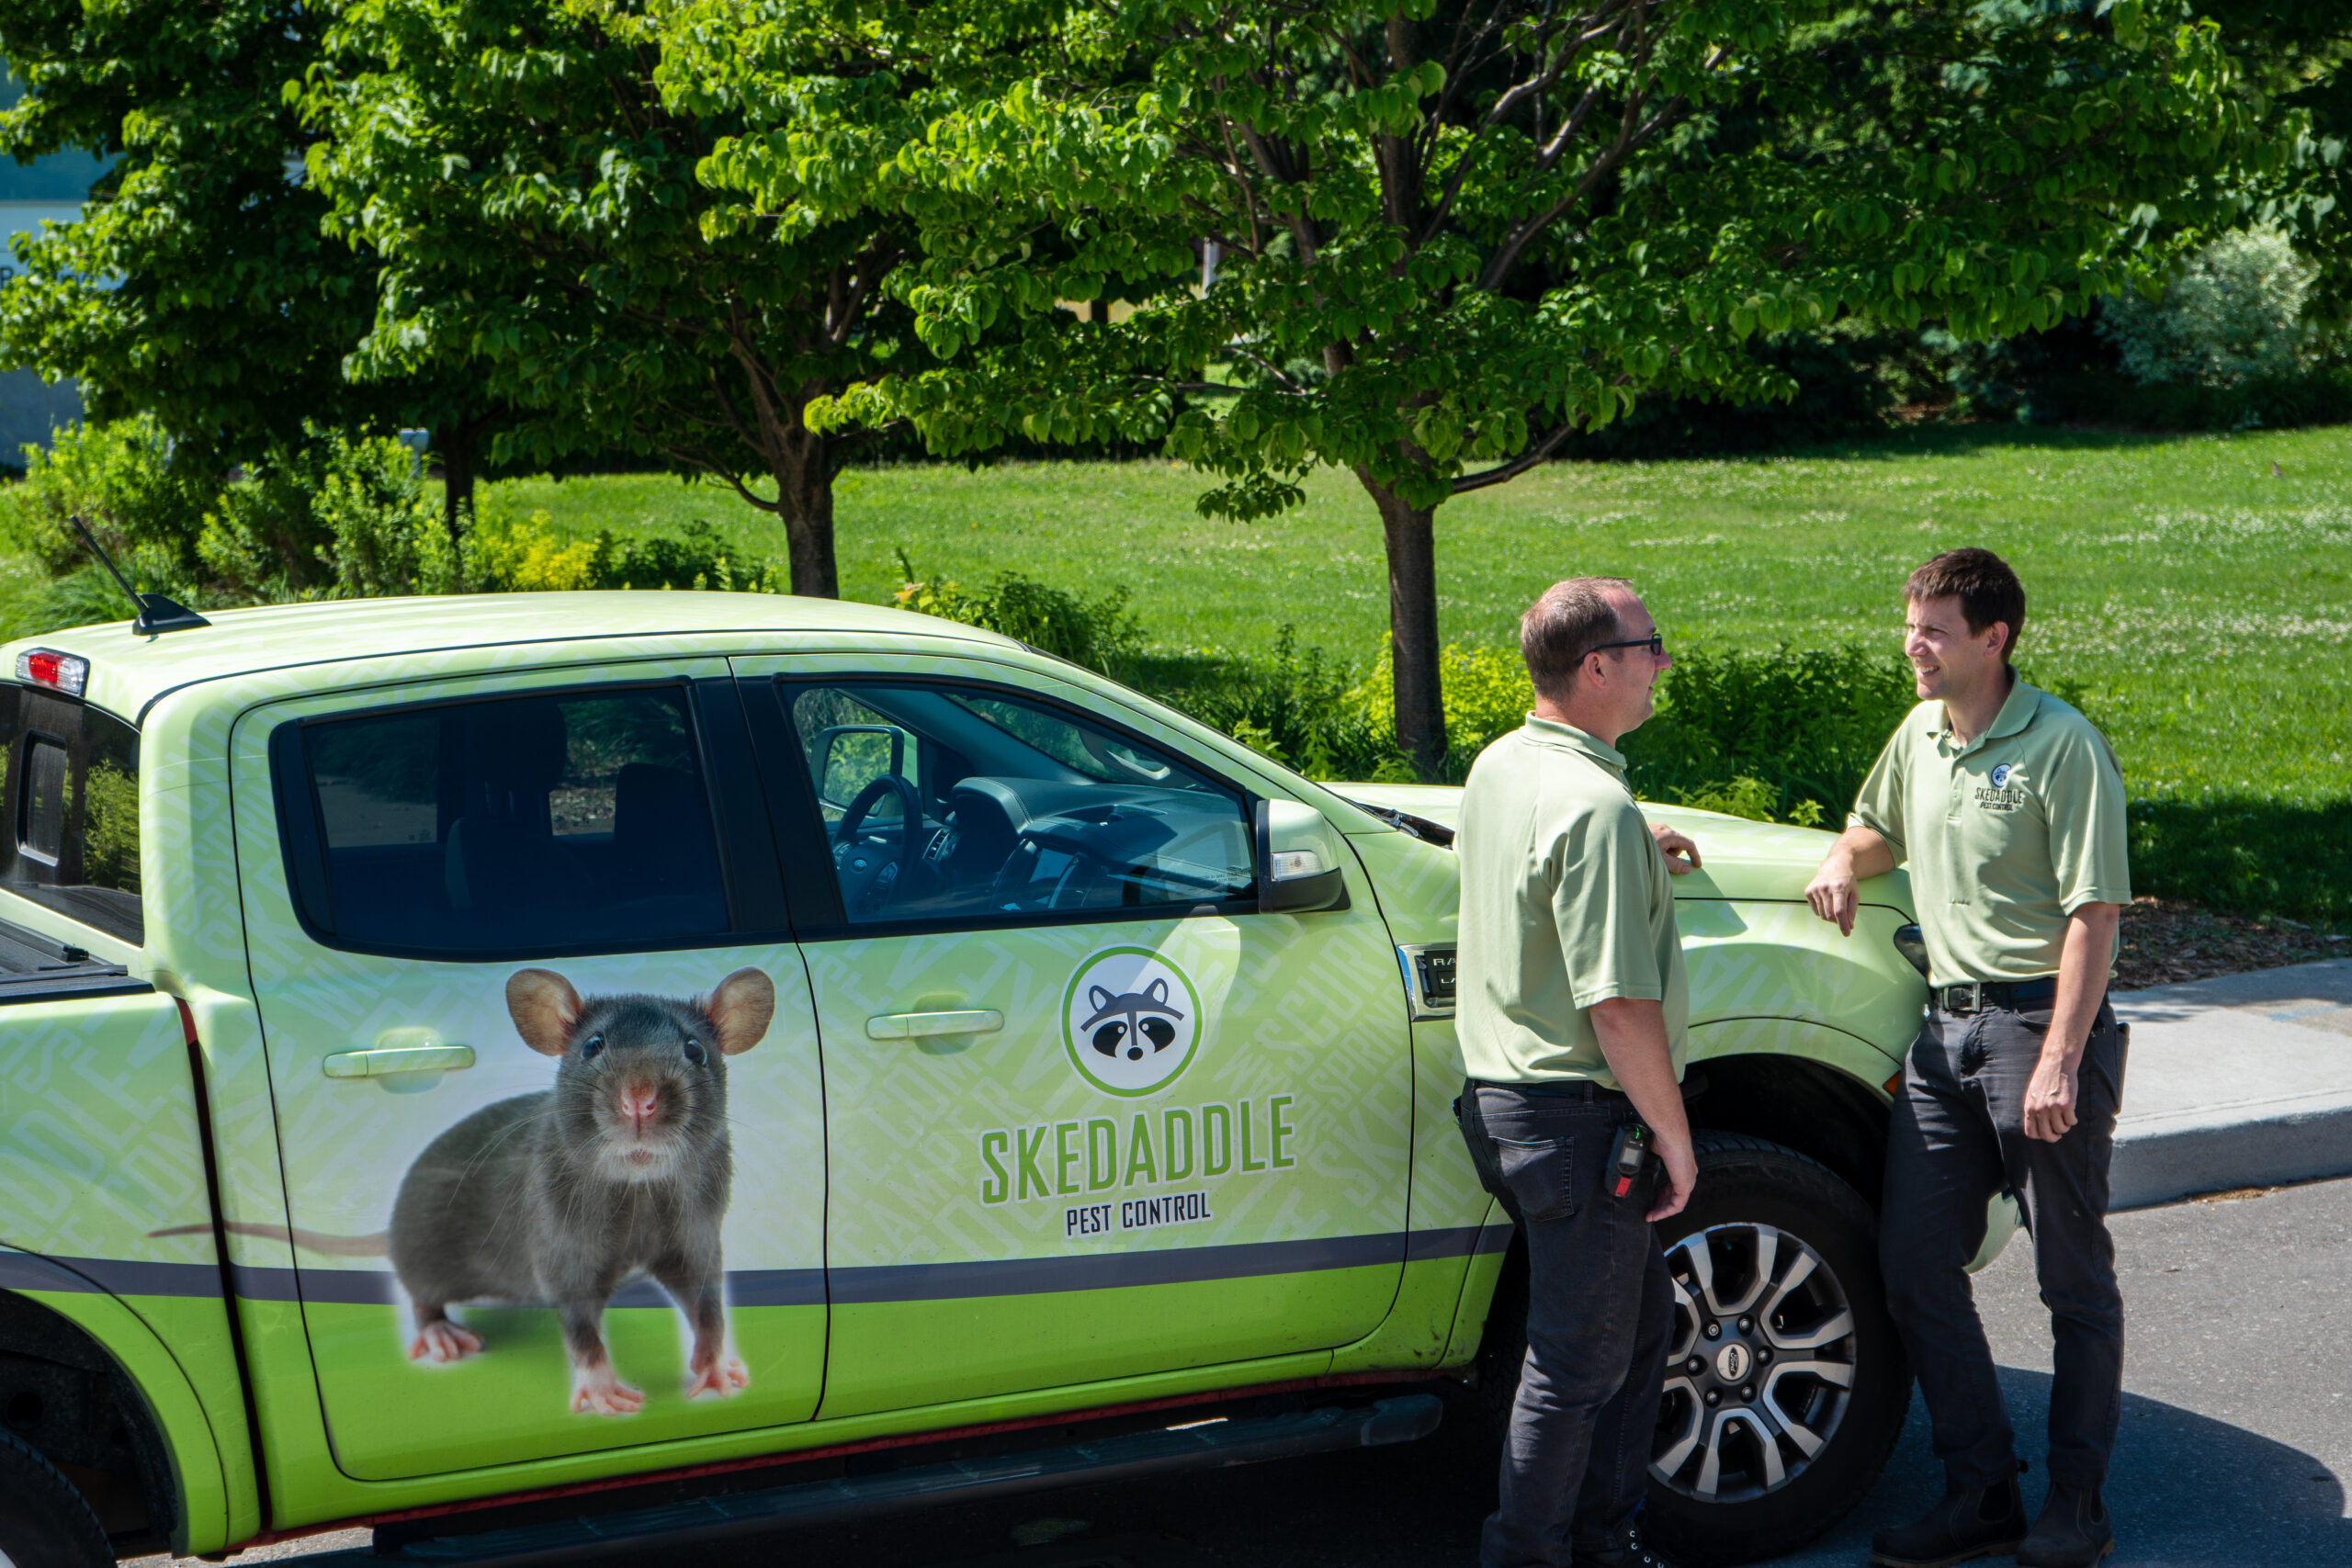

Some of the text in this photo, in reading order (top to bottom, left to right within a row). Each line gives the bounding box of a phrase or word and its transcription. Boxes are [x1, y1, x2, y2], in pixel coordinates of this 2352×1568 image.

[1975, 787, 2024, 804] SKEDADDLE
[980, 1094, 1295, 1205] SKEDADDLE
[1067, 1204, 1112, 1236] PEST
[1122, 1192, 1211, 1229] CONTROL
